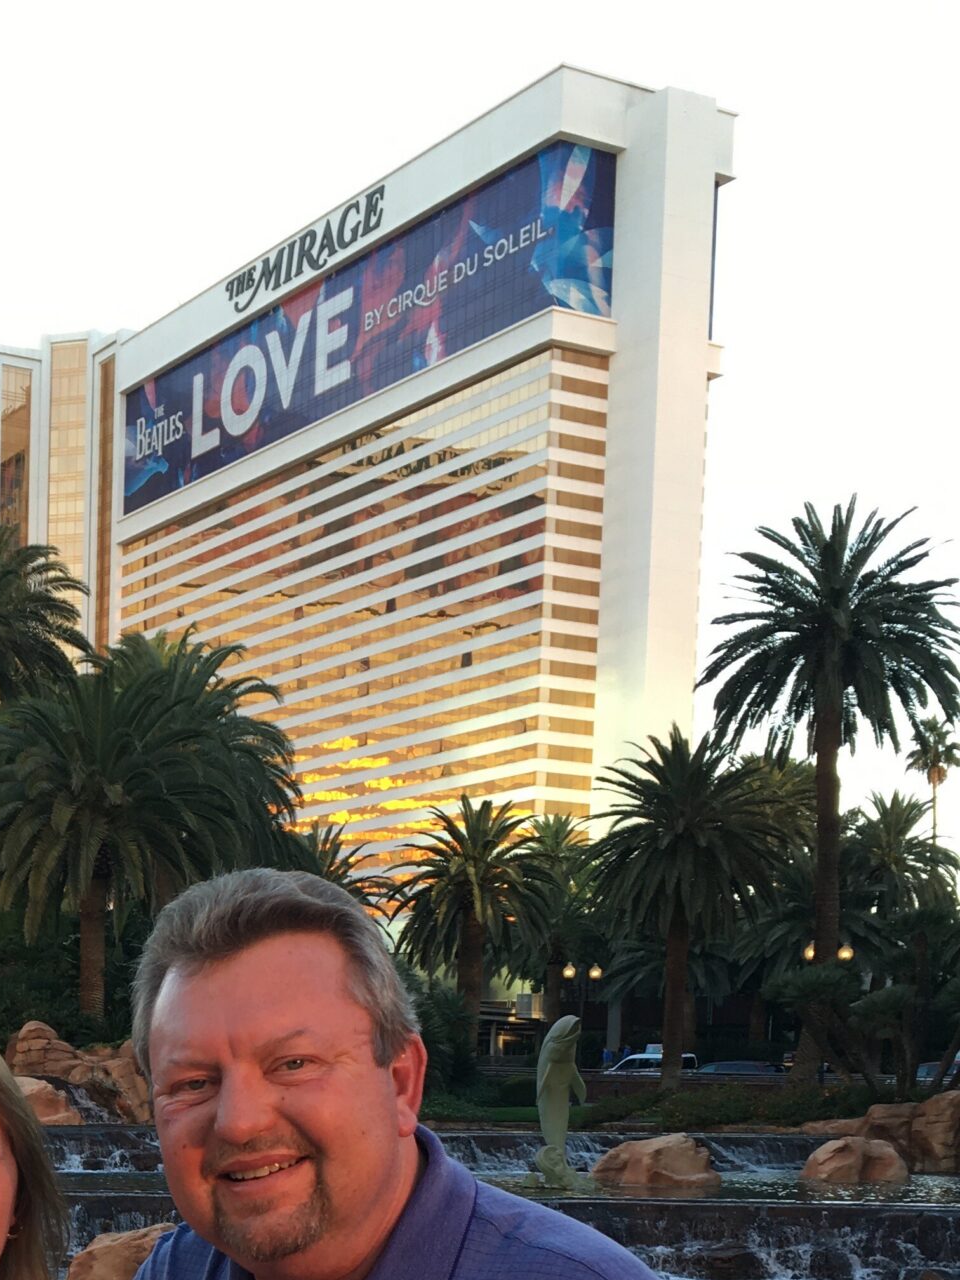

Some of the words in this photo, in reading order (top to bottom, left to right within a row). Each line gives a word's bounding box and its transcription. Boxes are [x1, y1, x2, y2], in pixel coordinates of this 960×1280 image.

[225, 265, 257, 301] THE
[234, 184, 385, 313] MIRAGE
[364, 304, 385, 332] BY
[387, 270, 448, 318] CIRQUE
[453, 254, 479, 284] DU
[483, 219, 548, 268] SOLEIL
[154, 404, 165, 419] THE
[191, 286, 354, 460] LOVE
[135, 411, 184, 461] BEATLES
